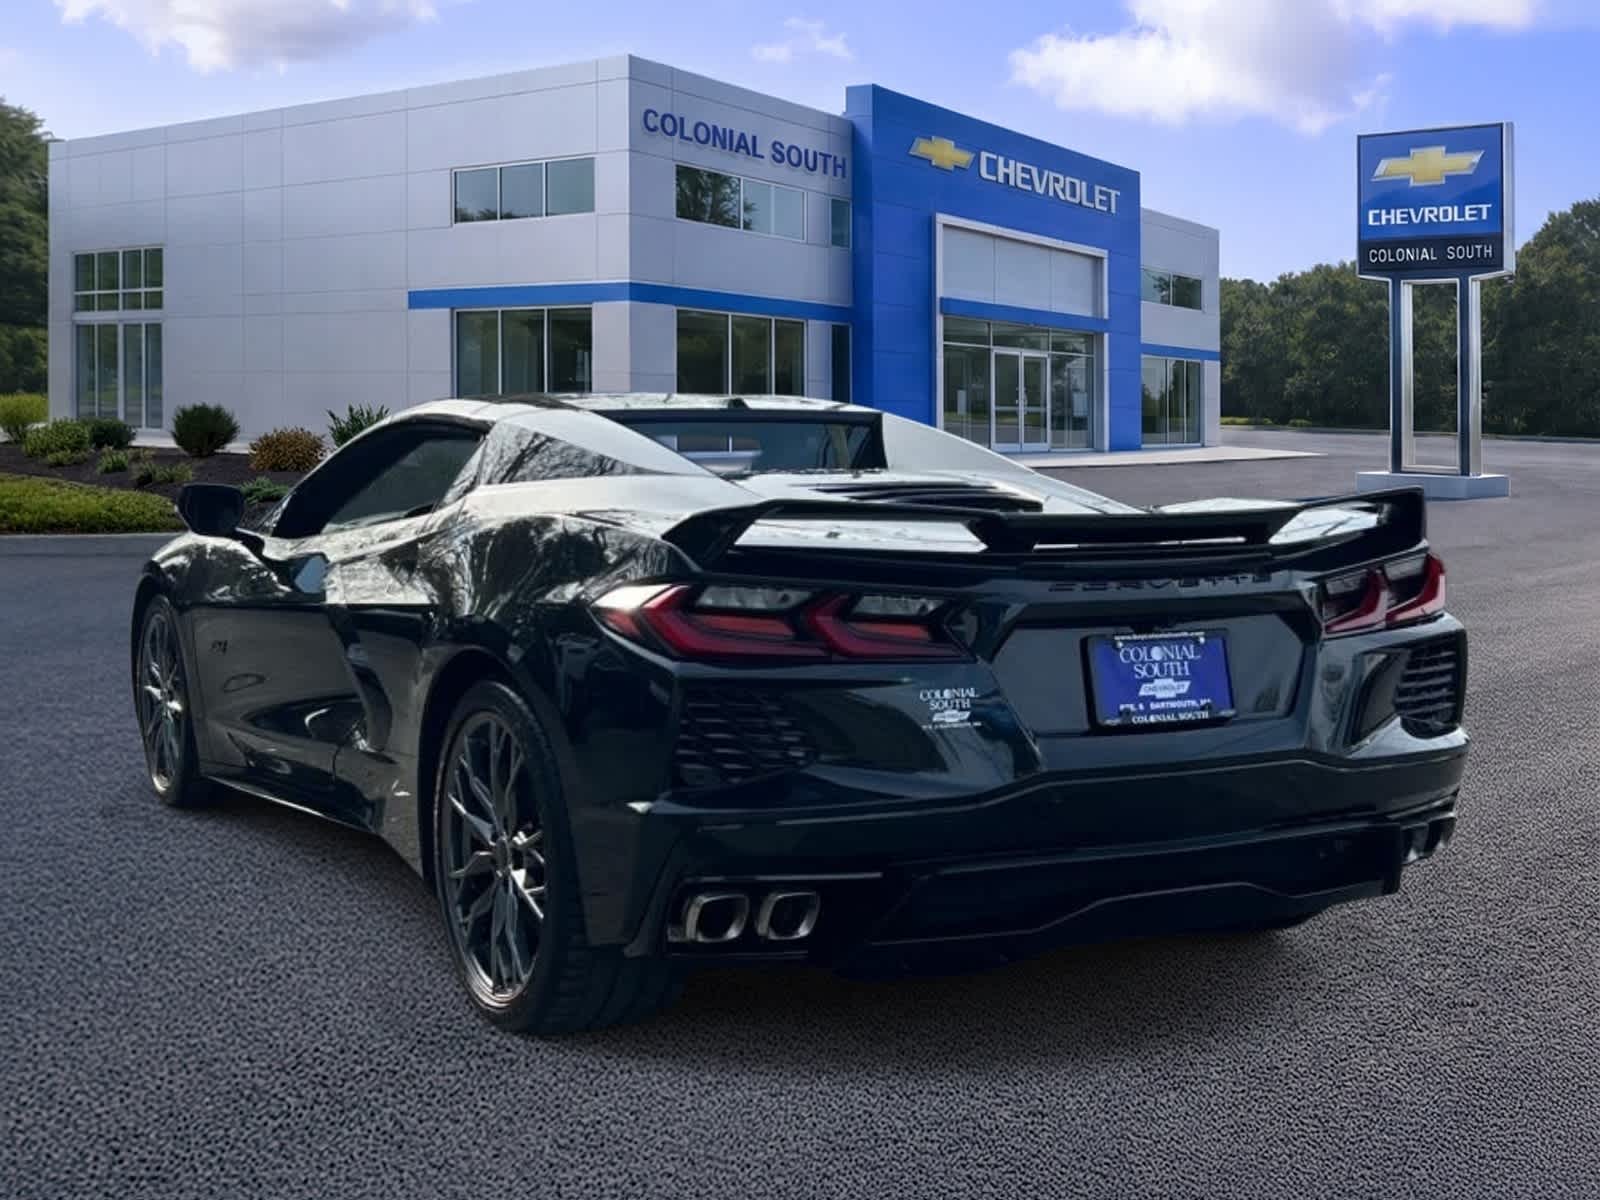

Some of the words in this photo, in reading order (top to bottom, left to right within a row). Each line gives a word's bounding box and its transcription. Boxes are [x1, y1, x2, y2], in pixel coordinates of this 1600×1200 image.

[643, 108, 765, 159] COLONIAL
[771, 140, 848, 179] SOUTH
[979, 150, 1121, 215] CHEVROLET
[1367, 203, 1493, 226] CHEVROLET
[1368, 247, 1438, 264] COLONIAL
[1446, 244, 1494, 261] SOUTH
[1119, 644, 1201, 664] COLONIAL
[1133, 660, 1191, 680] SOUTH
[919, 687, 980, 702] COLONIAL
[928, 698, 971, 711] SOUTH
[1131, 713, 1176, 725] COLONIAL
[1178, 710, 1210, 721] SOUTH
